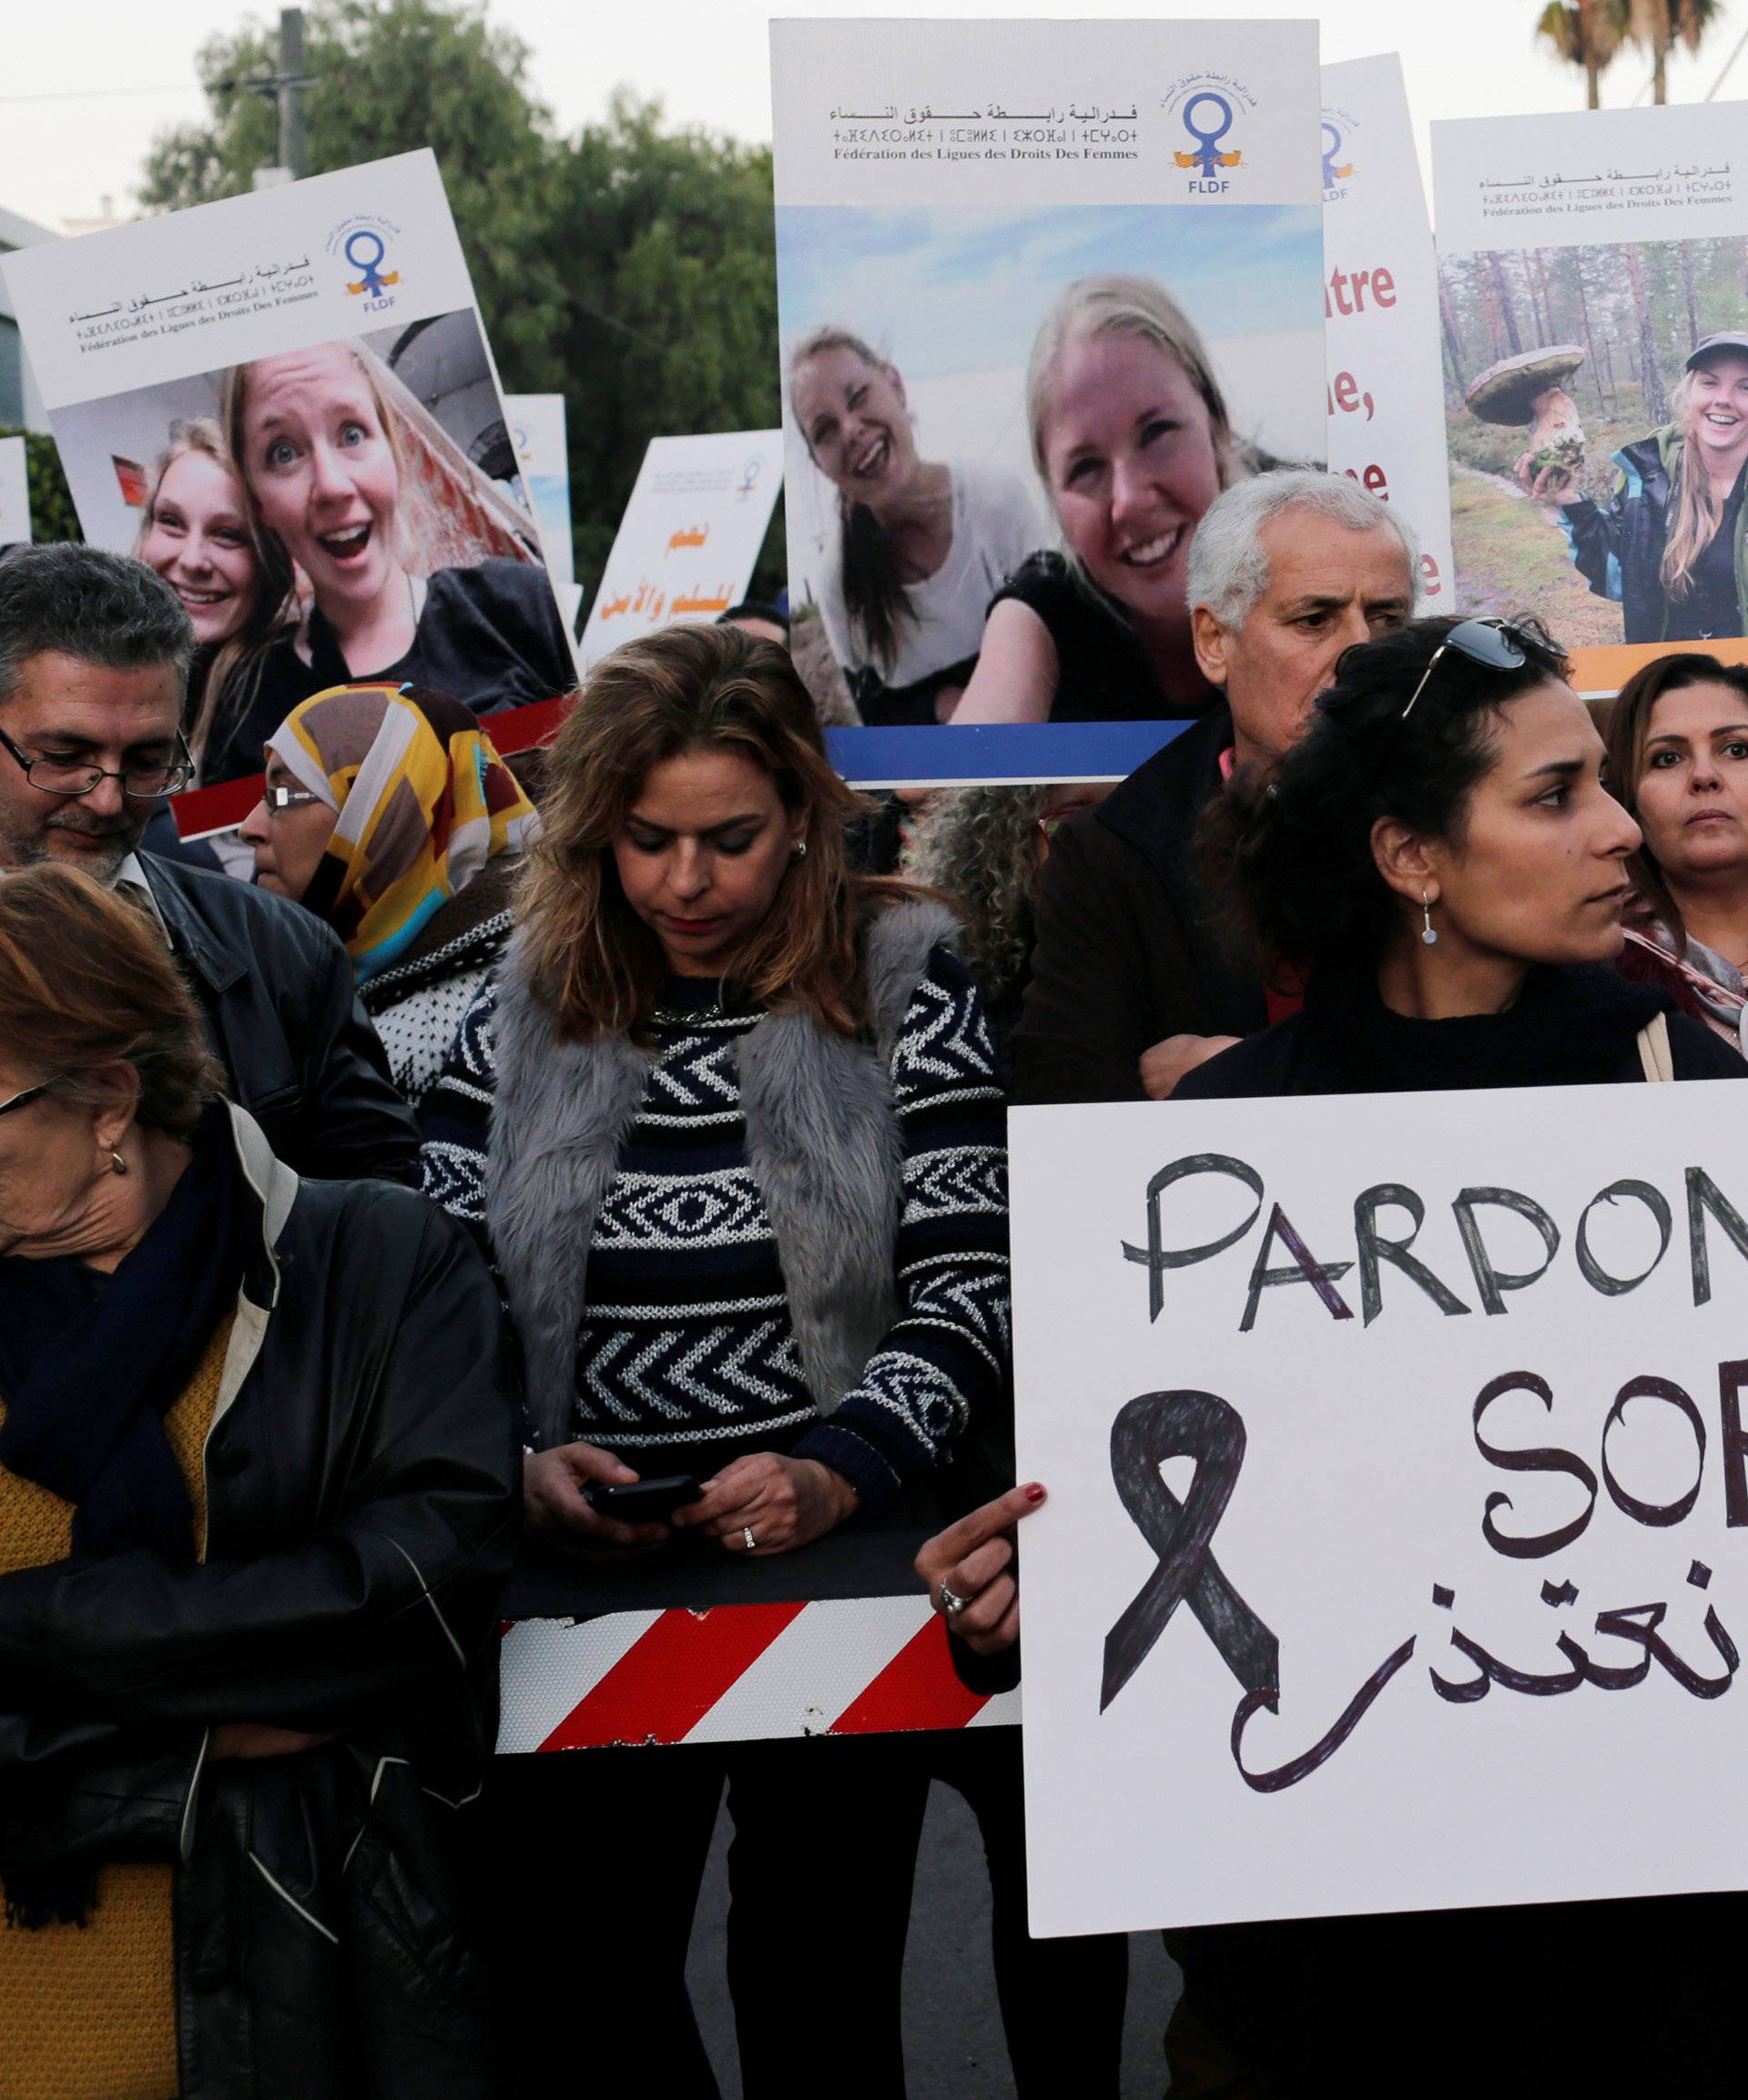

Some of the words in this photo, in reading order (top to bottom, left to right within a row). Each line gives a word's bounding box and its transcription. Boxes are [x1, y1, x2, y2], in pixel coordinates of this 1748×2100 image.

[834, 148, 906, 159] Fédération
[911, 148, 932, 159] des
[937, 148, 981, 161] Ligues
[984, 148, 1006, 159] des
[1011, 148, 1051, 159] Droits
[1056, 148, 1079, 159] Des
[1083, 148, 1138, 159] Femmes
[1188, 181, 1230, 194] FLDF
[1323, 188, 1347, 202] LDF
[1545, 205, 1563, 213] des
[1566, 204, 1602, 214] Ligues
[1606, 201, 1624, 210] des
[1627, 199, 1660, 209] Droits
[1664, 198, 1683, 207] Des
[1687, 196, 1733, 205] Femmes
[1326, 265, 1397, 319] tre
[364, 297, 395, 312] FLDF
[141, 330, 159, 340] des
[198, 316, 216, 325] des
[253, 302, 272, 312] Des
[664, 522, 710, 561] نعم
[1231, 1559, 1740, 1793] نعتذر
